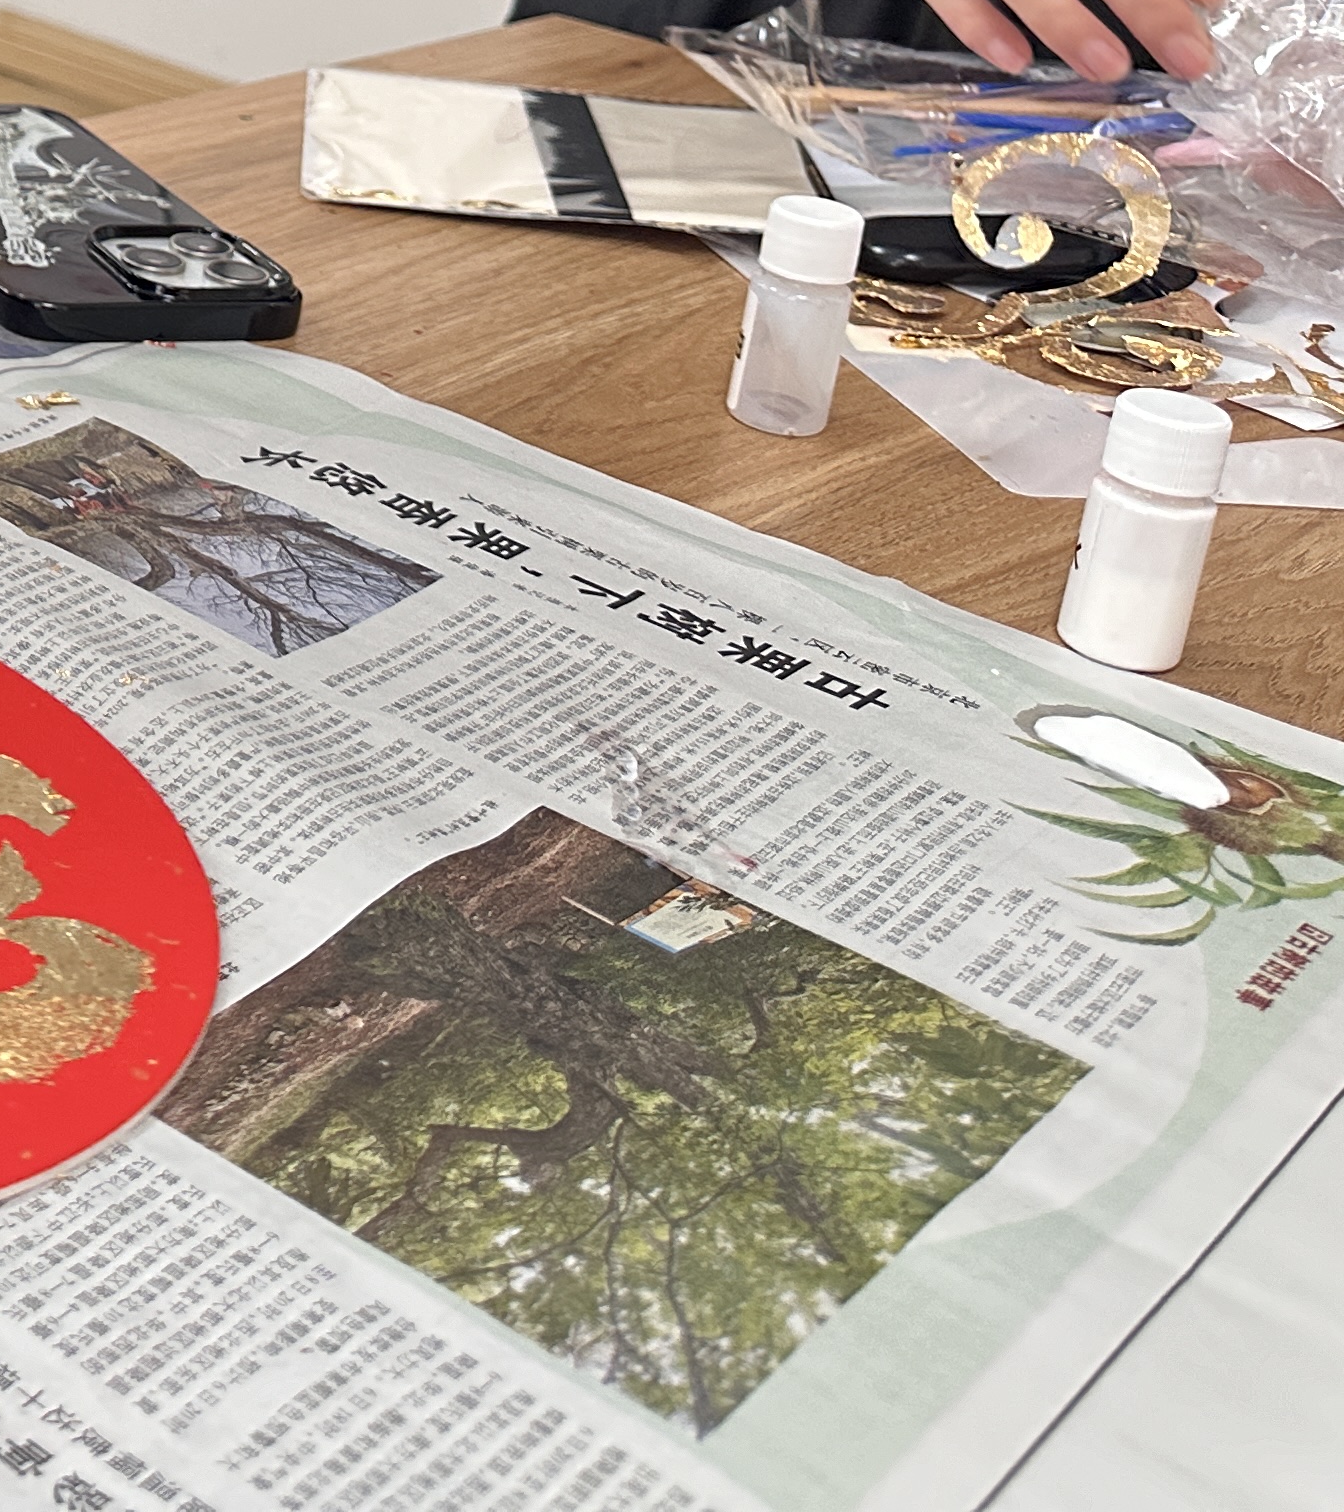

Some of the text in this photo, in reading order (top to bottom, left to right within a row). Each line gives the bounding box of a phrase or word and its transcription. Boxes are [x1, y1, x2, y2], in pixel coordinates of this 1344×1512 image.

[239, 445, 892, 717] 古栗树下，果香悠长
